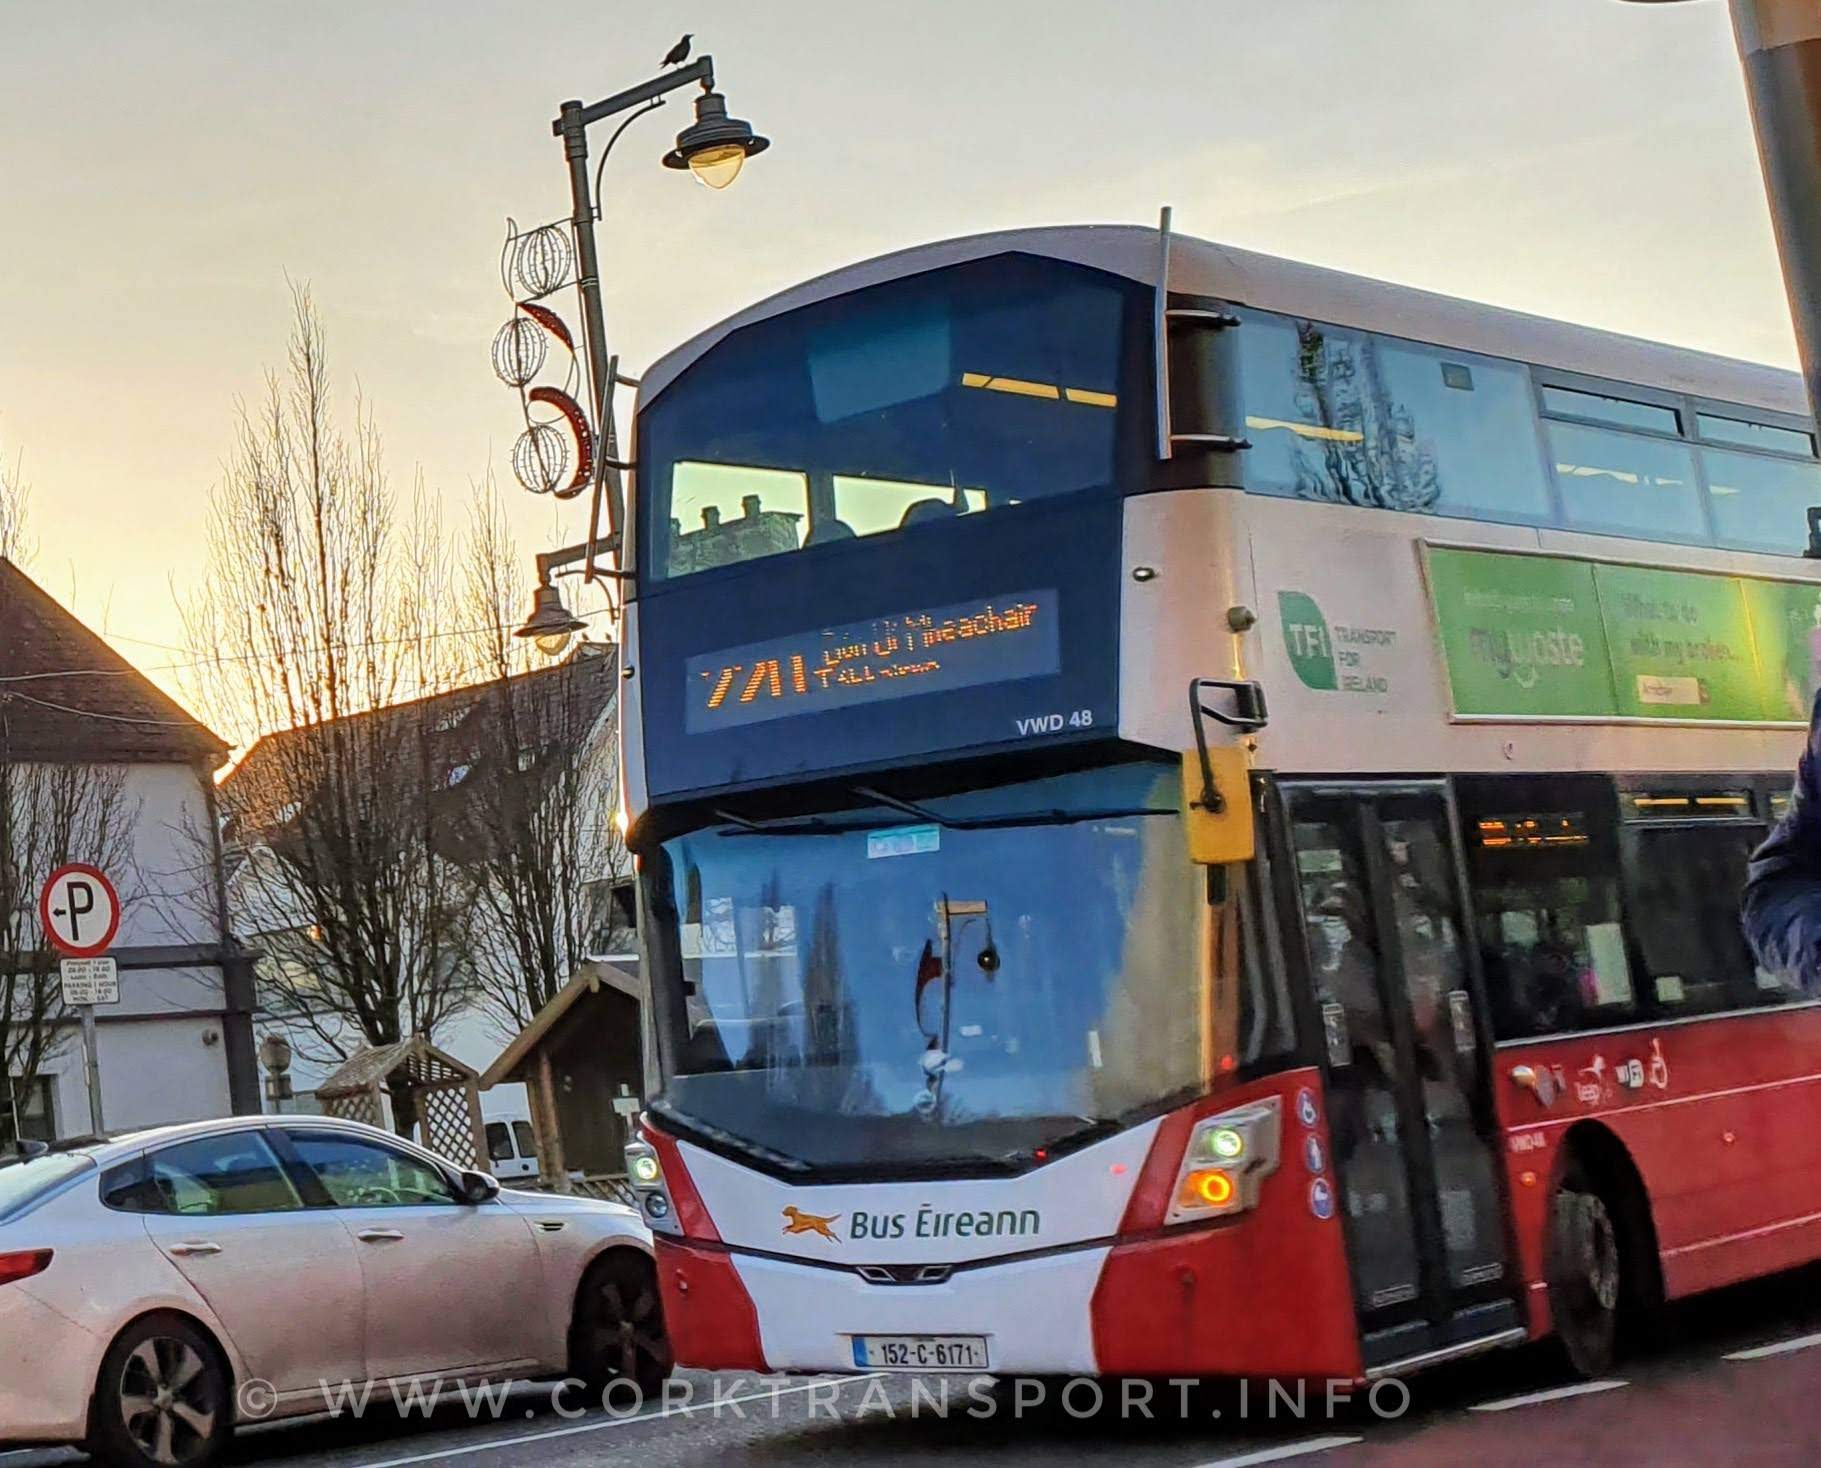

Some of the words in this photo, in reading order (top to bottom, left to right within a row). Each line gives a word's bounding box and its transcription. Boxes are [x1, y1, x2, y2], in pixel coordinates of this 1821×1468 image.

[1289, 623, 1328, 659] TFI
[1016, 714, 1064, 736] VWD
[1069, 709, 1093, 728] 48
[66, 881, 94, 942] P
[850, 1211, 905, 1240] Bus
[915, 1203, 1041, 1239] Éireann
[881, 1343, 973, 1365] 152-C-6171
